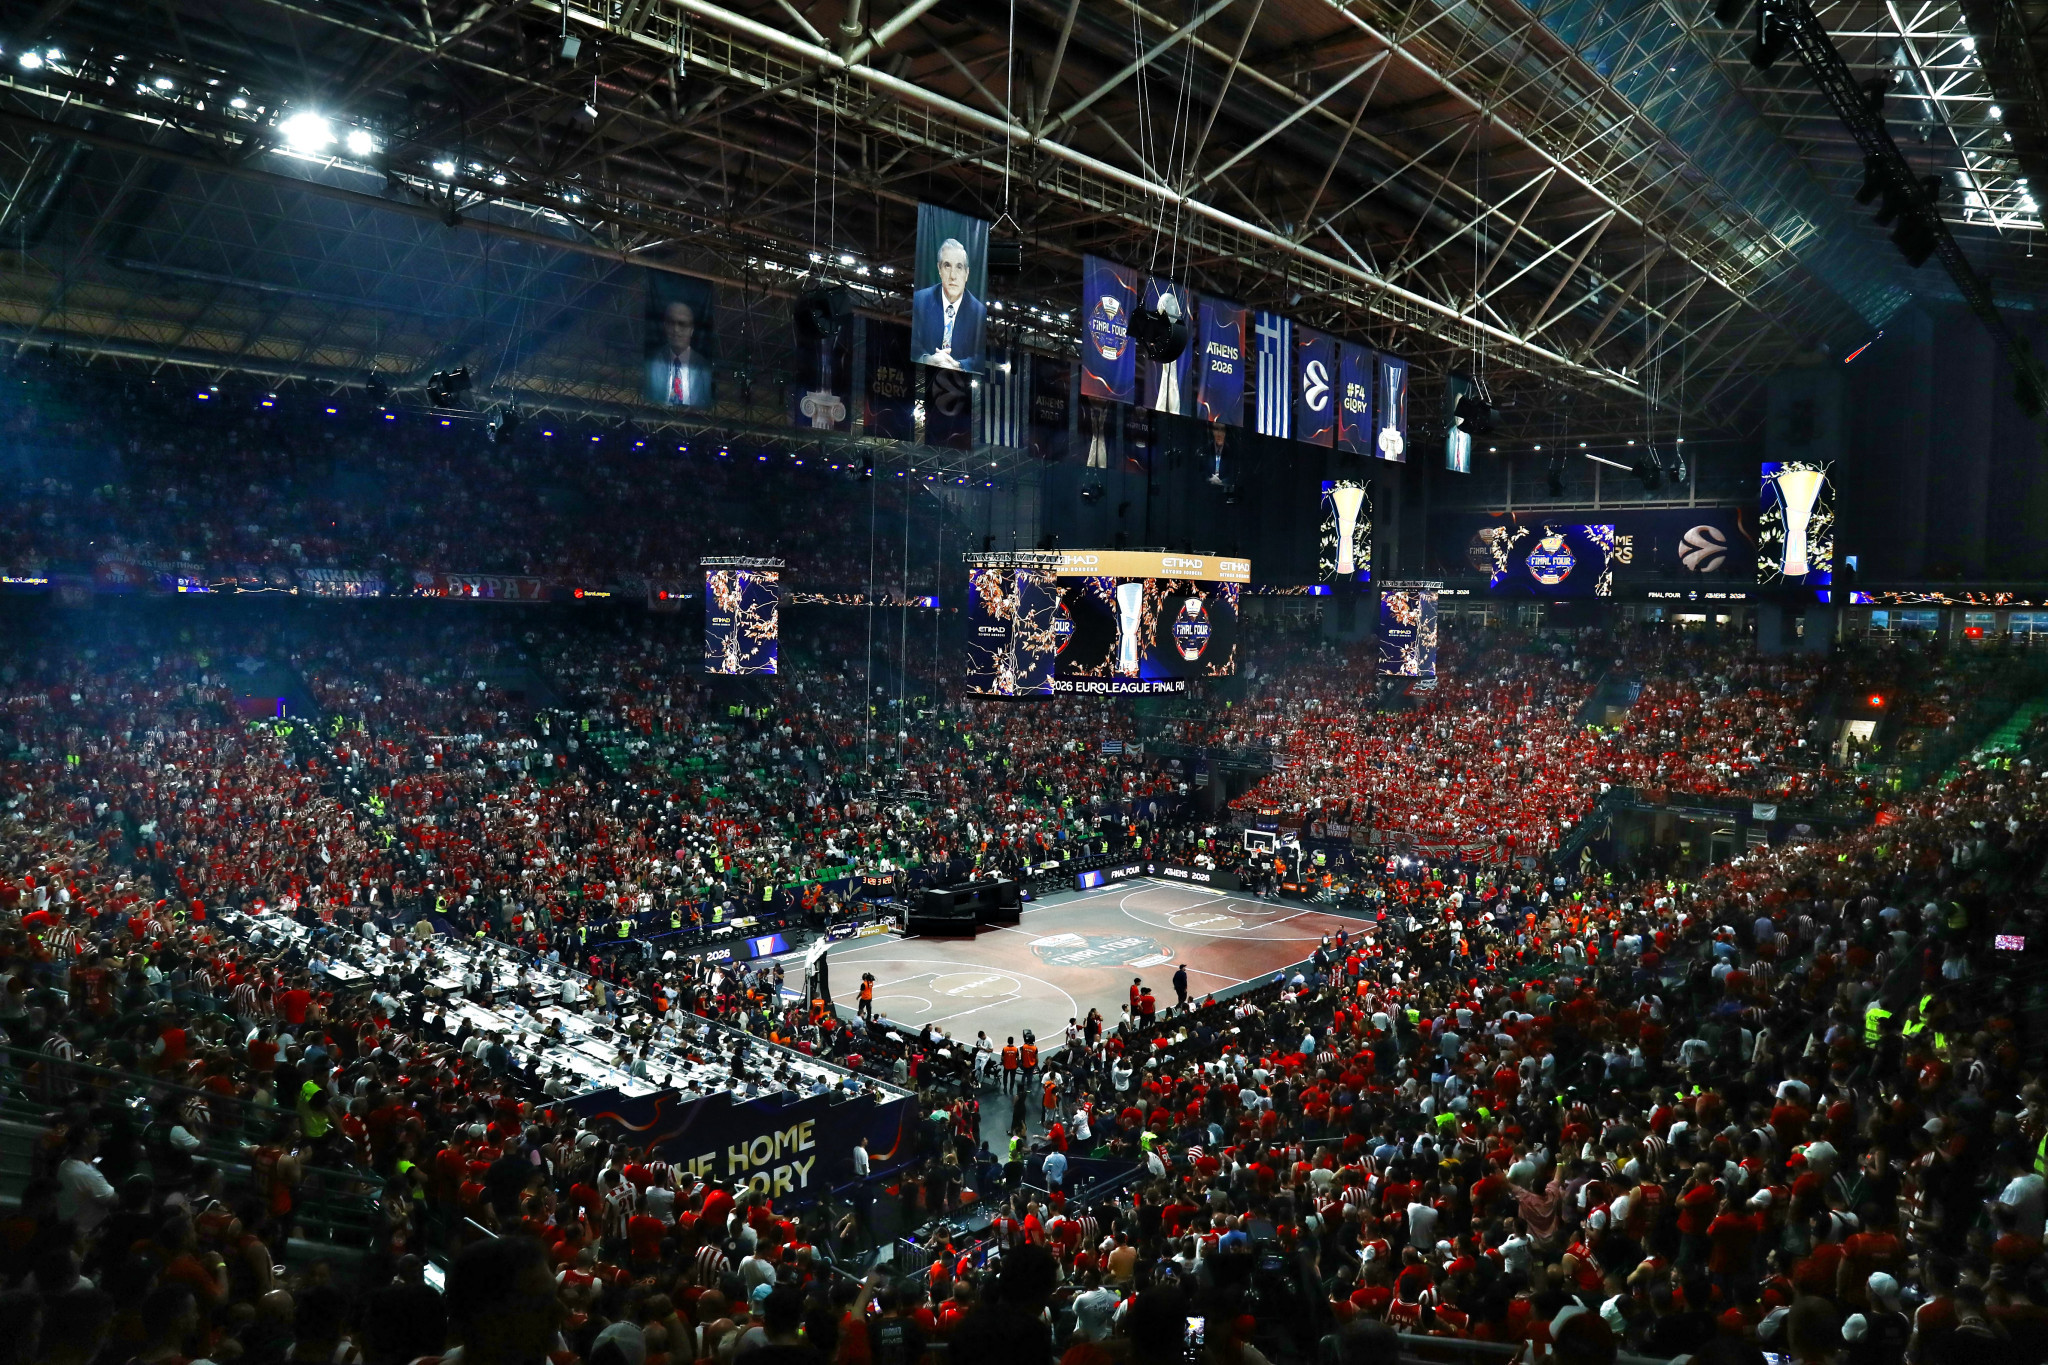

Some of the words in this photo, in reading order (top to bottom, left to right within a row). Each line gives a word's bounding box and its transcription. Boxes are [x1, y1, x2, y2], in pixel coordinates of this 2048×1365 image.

[1112, 324, 1127, 337] FOUR
[1206, 341, 1238, 360] ATHENS
[1211, 359, 1232, 374] 2026
[877, 366, 904, 384] #F4
[872, 381, 908, 397] GLORY
[1347, 382, 1365, 400] #F4
[1344, 397, 1367, 413] GLORY
[1162, 557, 1203, 568] ETIHAD
[1220, 562, 1250, 572] ETIHAD
[1553, 557, 1571, 566] FOUR
[1194, 625, 1208, 635] FOUR
[1076, 682, 1151, 694] EUROLEAGUE
[1153, 682, 1174, 692] FINAL
[1111, 869, 1126, 878] FINAL
[1126, 866, 1140, 876] FOUR
[1164, 868, 1188, 879] ATHENS
[1191, 872, 1210, 882] 2026
[706, 949, 730, 961] 2026
[728, 1119, 815, 1176] HOME
[618, 1195, 635, 1215] 21
